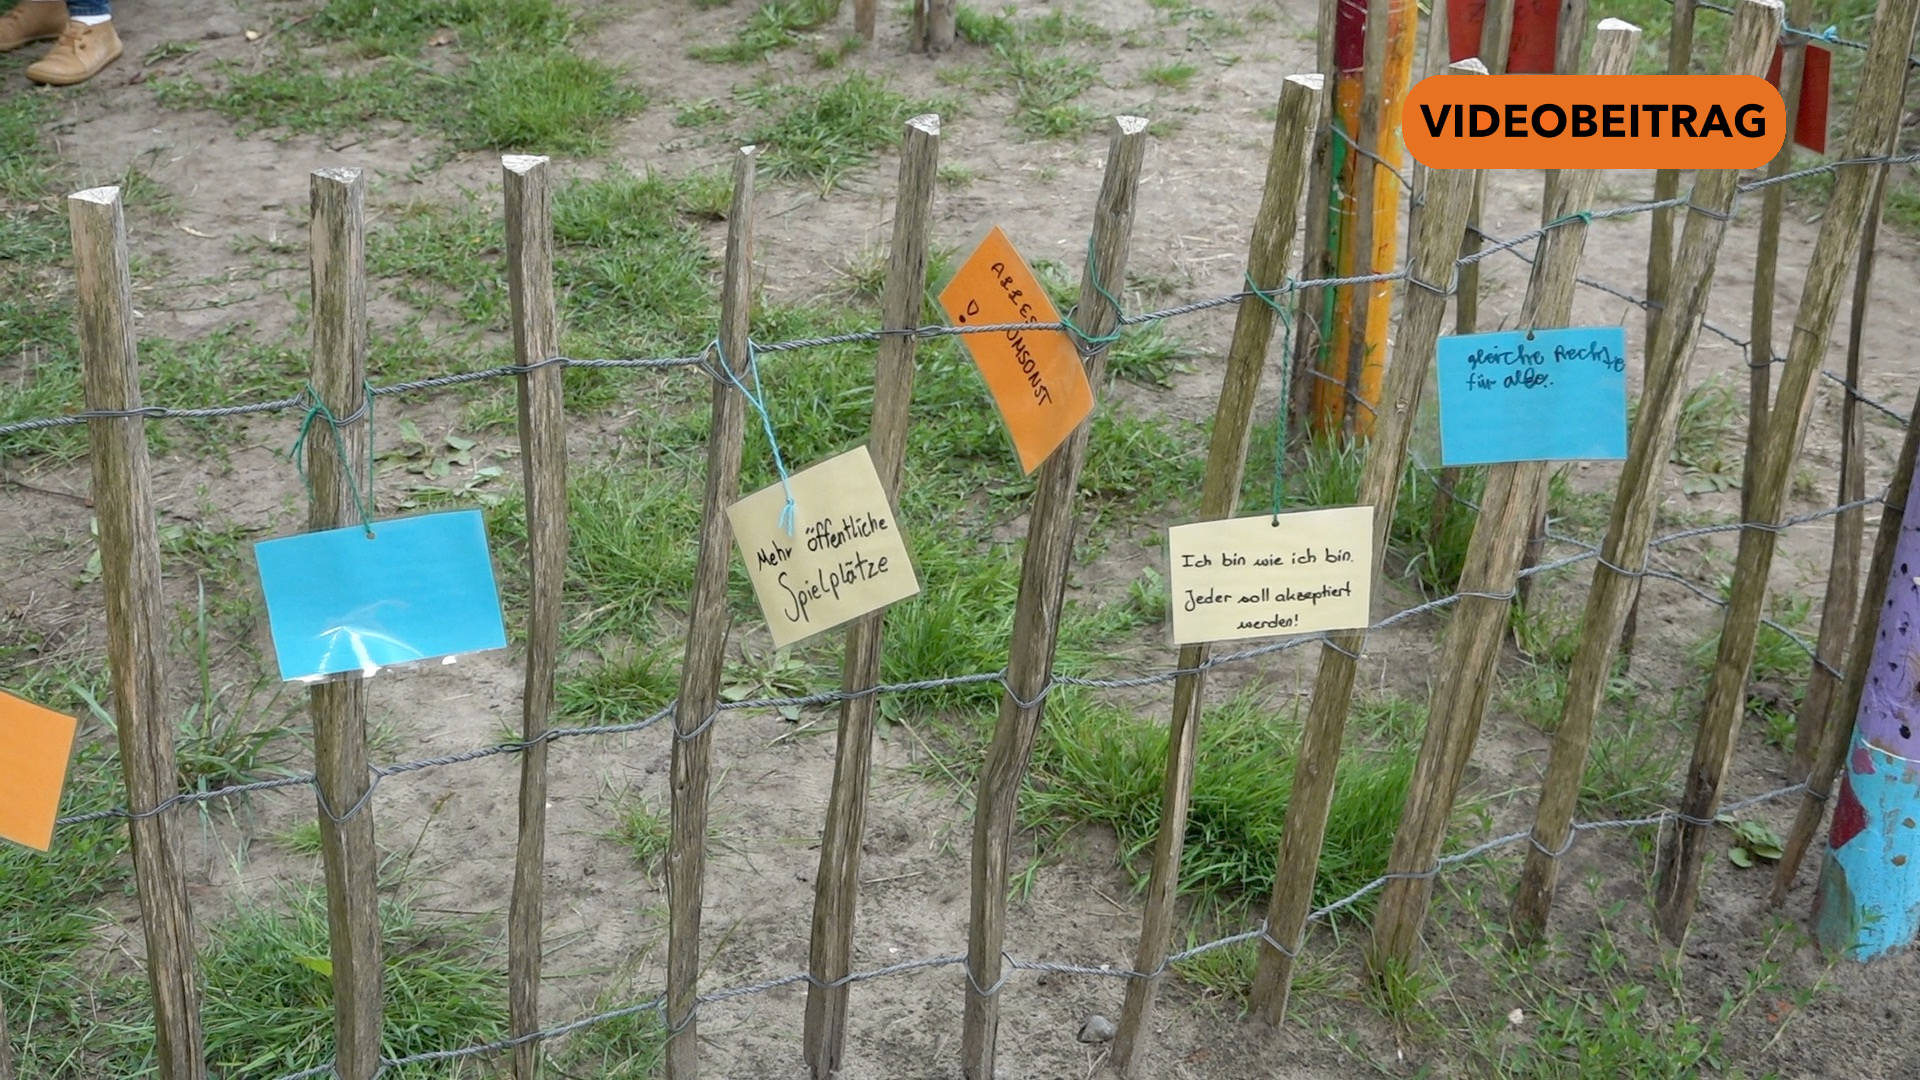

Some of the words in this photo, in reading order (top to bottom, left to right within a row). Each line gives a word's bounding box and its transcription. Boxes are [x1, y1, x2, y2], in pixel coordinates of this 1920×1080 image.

[757, 540, 793, 571] Mehr
[804, 511, 889, 552] öffentliche
[1181, 554, 1212, 569] Ich
[1221, 552, 1246, 567] bin
[1253, 553, 1284, 568] wie
[1291, 548, 1317, 565] ich
[1324, 547, 1355, 564] bin.
[778, 551, 889, 624] Spielplätze
[1184, 587, 1233, 612] Jeder
[1237, 587, 1270, 604] soll
[1275, 581, 1352, 606] akzeptiert
[1236, 613, 1299, 631] werden!
